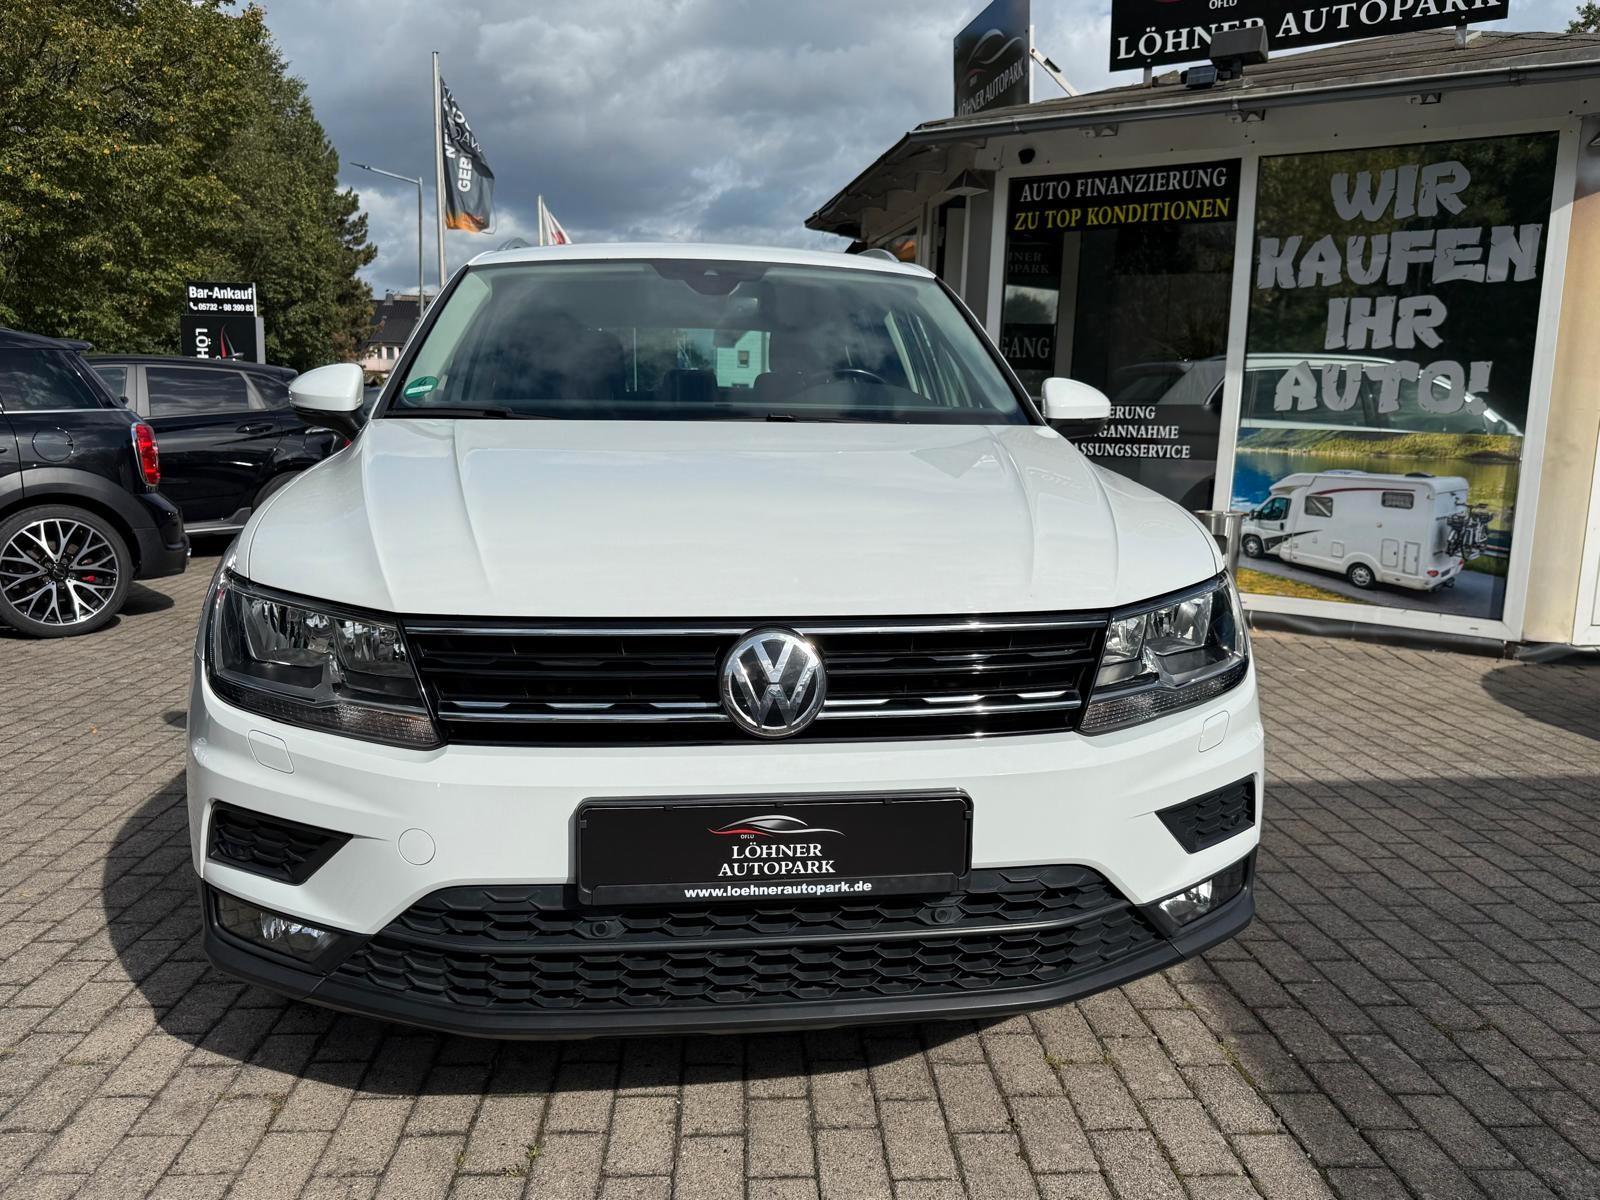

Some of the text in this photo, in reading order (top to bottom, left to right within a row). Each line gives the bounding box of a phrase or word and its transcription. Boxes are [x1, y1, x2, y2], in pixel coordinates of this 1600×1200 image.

[1208, 0, 1238, 10] OFLU
[1275, 0, 1501, 38] AUTOPA
[985, 57, 1025, 102] AUTOPARK
[1020, 167, 1227, 202] AUTO FINANZIERUNG
[1330, 160, 1471, 222] WIR
[1014, 197, 1231, 231] ZU TOP KONDITIONEN
[1256, 223, 1543, 290] KAUFEN
[188, 285, 253, 300] Bar-Ankauf
[198, 303, 218, 311] 05732
[223, 303, 232, 311] 98
[232, 304, 245, 312] 399
[245, 304, 254, 312] 83
[1324, 294, 1448, 350] IHR
[1273, 360, 1494, 416] AUTO!
[1093, 425, 1179, 439] GANNAHME
[731, 842, 823, 859] LÖHNER
[718, 860, 836, 877] AUTOPARK
[684, 881, 872, 899] www.loehnerautopark.de
